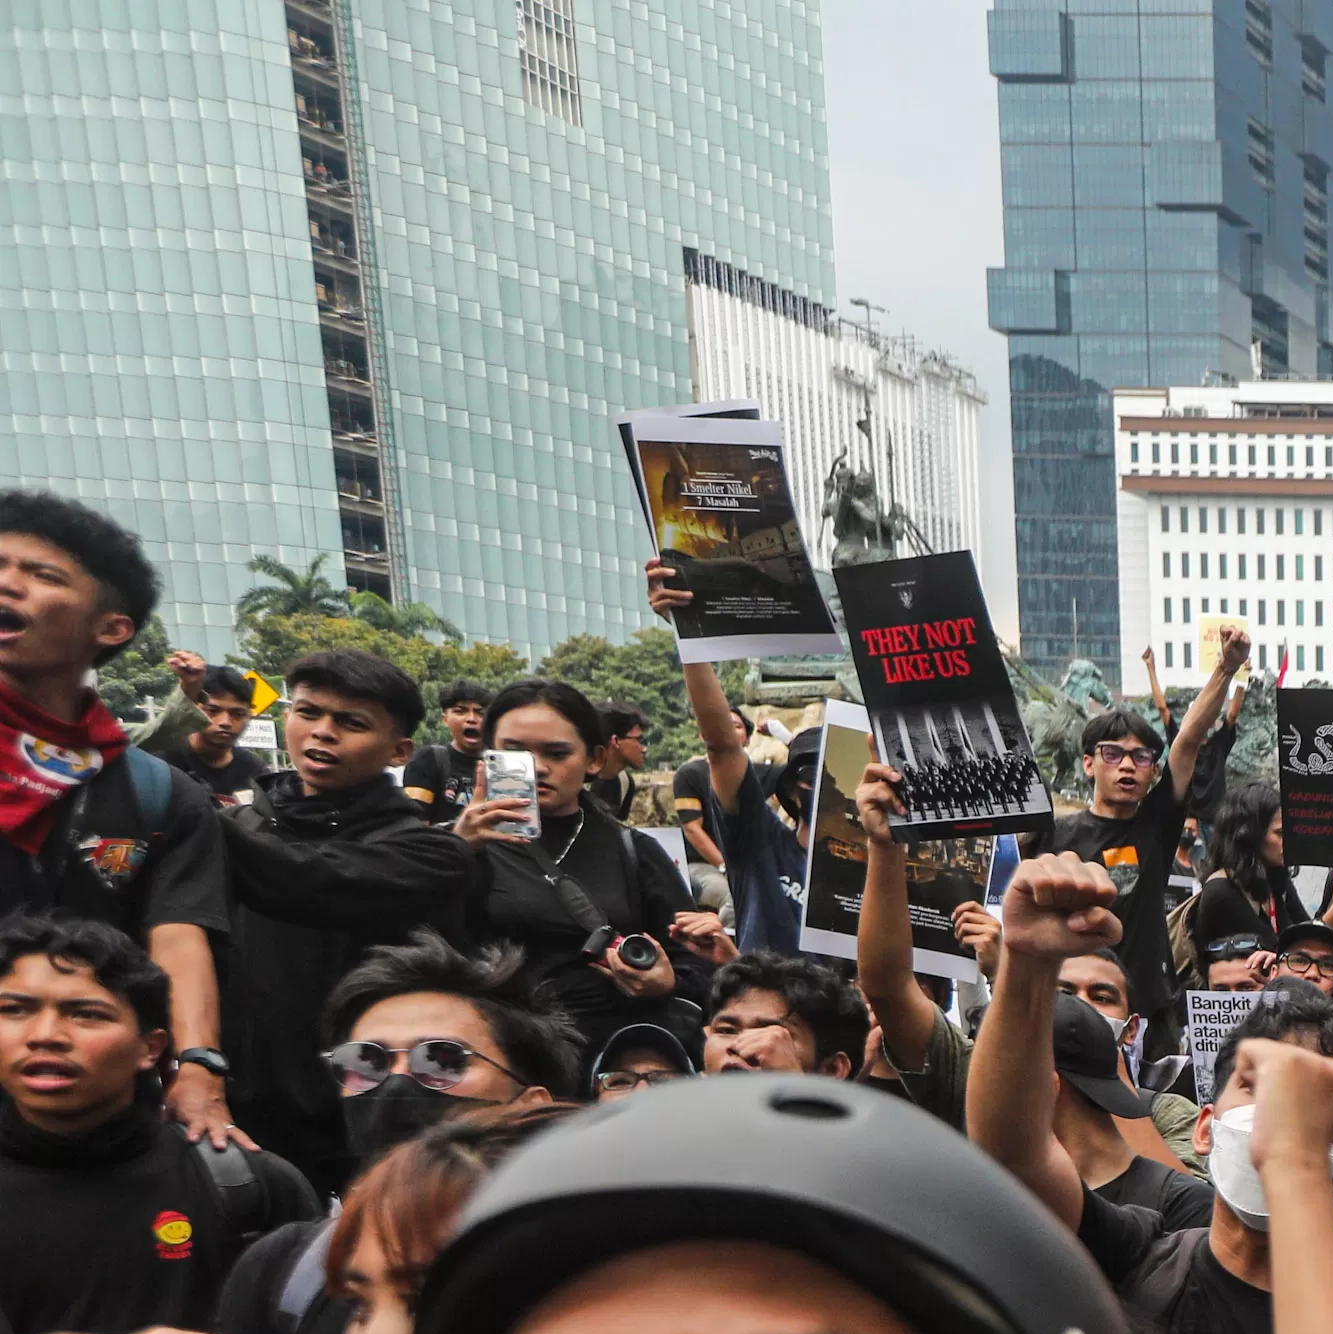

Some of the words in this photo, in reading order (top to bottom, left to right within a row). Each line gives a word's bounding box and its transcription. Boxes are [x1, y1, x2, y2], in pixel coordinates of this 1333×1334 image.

[683, 482, 689, 493] 1
[690, 482, 725, 494] Smelter
[727, 483, 753, 496] Nikel
[696, 496, 703, 506] 7
[705, 496, 740, 508] Masalah
[861, 622, 922, 656] THEY
[923, 617, 977, 649] NOT
[881, 654, 935, 684] LIKE
[933, 650, 971, 677] US
[1192, 996, 1252, 1016] Bangkit
